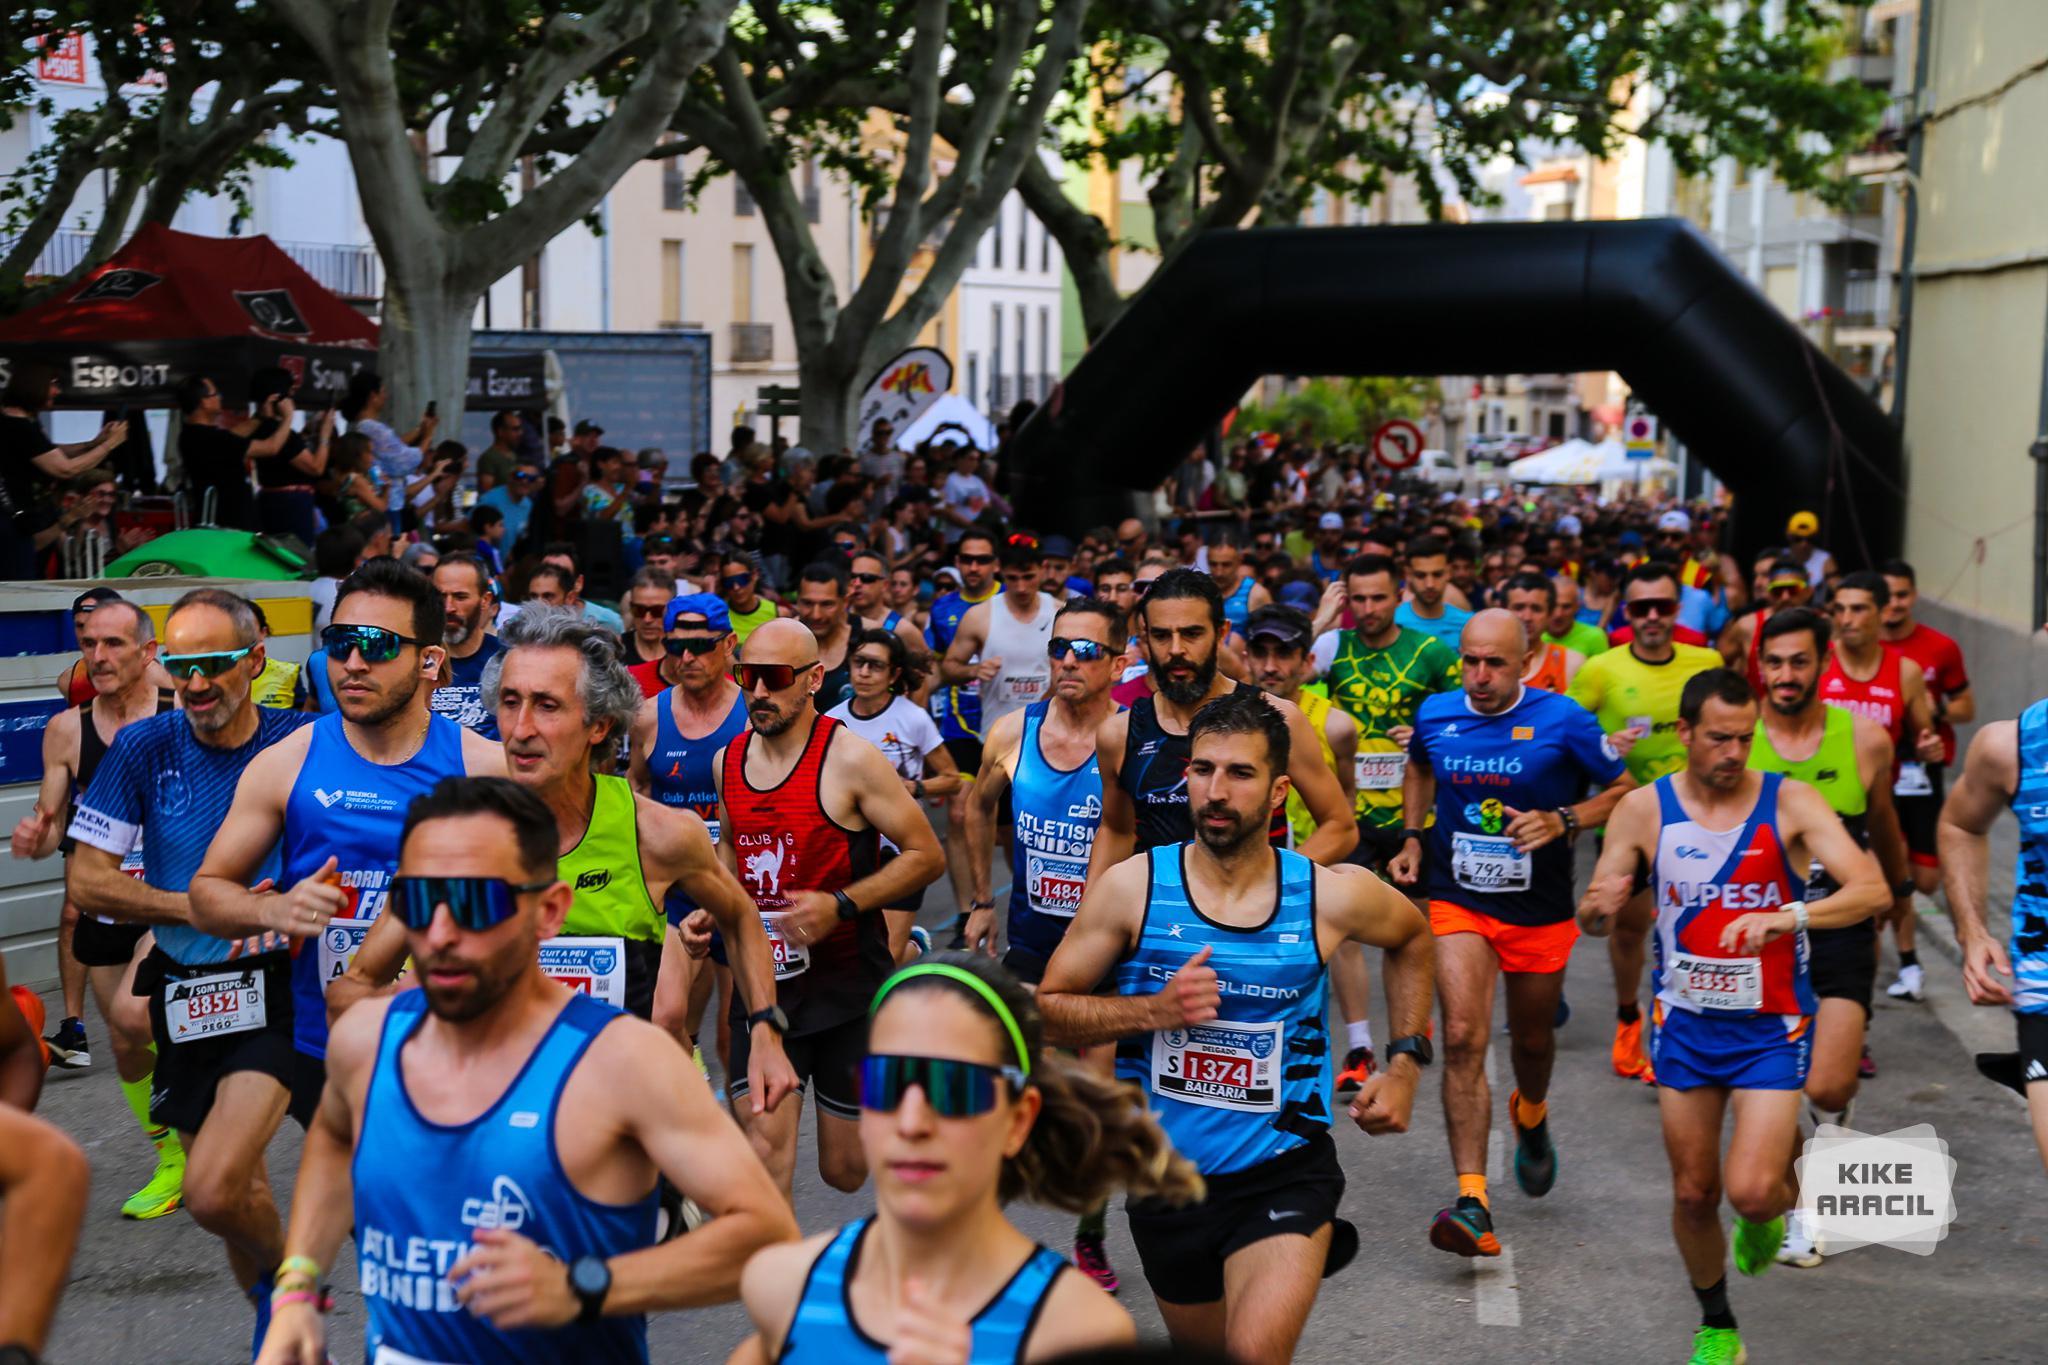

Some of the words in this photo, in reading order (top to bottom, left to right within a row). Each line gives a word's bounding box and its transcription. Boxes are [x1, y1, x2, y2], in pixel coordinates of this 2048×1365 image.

[71, 355, 170, 389] ESPORT
[1443, 755, 1523, 774] triatló
[1068, 797, 1101, 819] cab
[1017, 810, 1096, 842] ATLETISM
[739, 834, 772, 846] CLUB
[1017, 825, 1093, 859] BENIDO
[340, 870, 385, 888] BORN
[1475, 862, 1505, 877] 792
[1033, 879, 1040, 893] D
[1043, 880, 1082, 900] 1484
[1663, 881, 1784, 909] ALPESA
[196, 984, 216, 996] SOM
[189, 991, 237, 1018] 3852
[202, 1020, 232, 1033] PEGO
[1202, 1045, 1237, 1055] DELGADO
[1167, 1055, 1179, 1073] S
[1189, 1057, 1248, 1086] 1374
[1184, 1080, 1248, 1100] BALEARIA
[460, 1190, 530, 1230] cab
